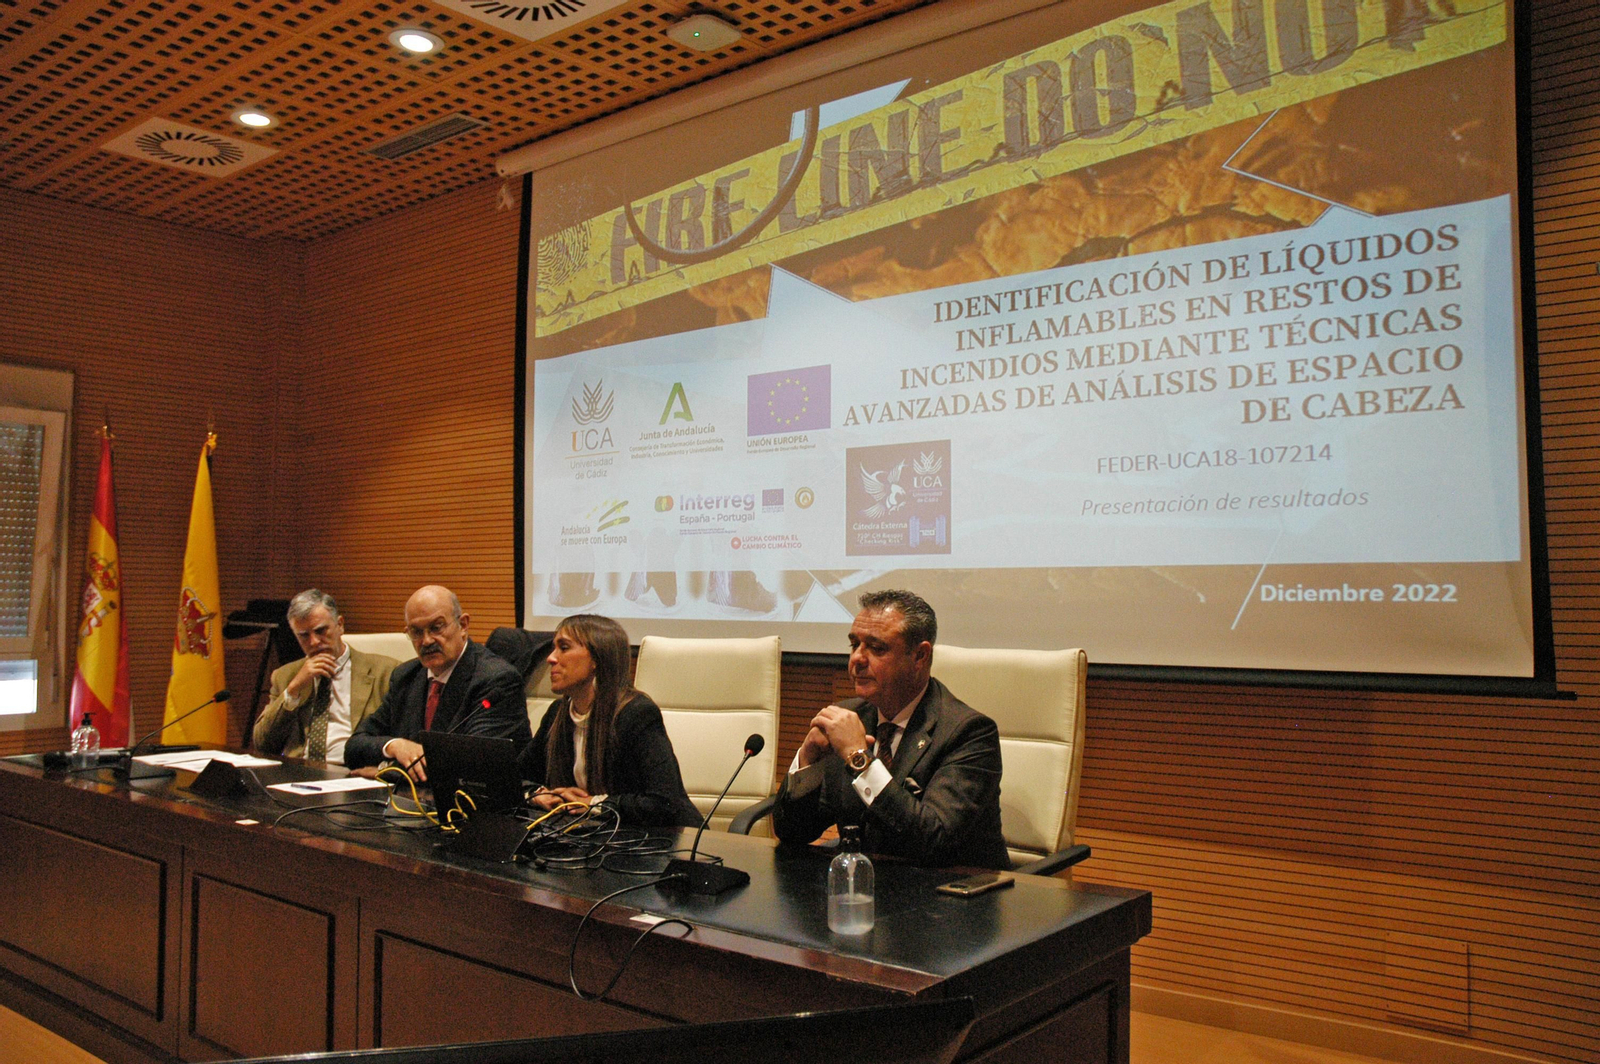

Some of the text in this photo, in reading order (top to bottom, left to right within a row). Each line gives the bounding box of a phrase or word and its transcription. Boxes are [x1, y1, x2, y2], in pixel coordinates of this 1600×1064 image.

[778, 89, 968, 233] LINE
[1003, 33, 1137, 160] DO
[934, 224, 1459, 323] IDENTIFICACIÓN DE LÍQUIDOS
[956, 264, 1461, 351] INFLAMABLES EN RESTOS DE
[900, 303, 1462, 390] INCENDIOS MEDIANTE TÉCNICAS
[843, 344, 1463, 427] AVANZADAS DE ANÁLISIS DE ESPACIO
[1241, 383, 1465, 424] DE CABEZA
[571, 427, 614, 452] UCA
[639, 423, 715, 441] Junta de Andalucía
[747, 435, 808, 448] UNIÓN EUROPEA
[570, 457, 613, 469] Universidad
[1097, 444, 1333, 474] FEDER-UCA18-107214
[575, 469, 607, 480] de Cádiz
[913, 476, 943, 488] UCA
[679, 493, 755, 511] Interreg
[1081, 488, 1370, 516] Presentación de resultados
[680, 513, 710, 525] España
[717, 512, 755, 524] Portugal
[852, 521, 908, 531] Cátedra Externa
[561, 533, 627, 546] se mueve con Europa
[742, 536, 763, 544] LUCHA
[1260, 583, 1459, 602] Diciembre 2022
